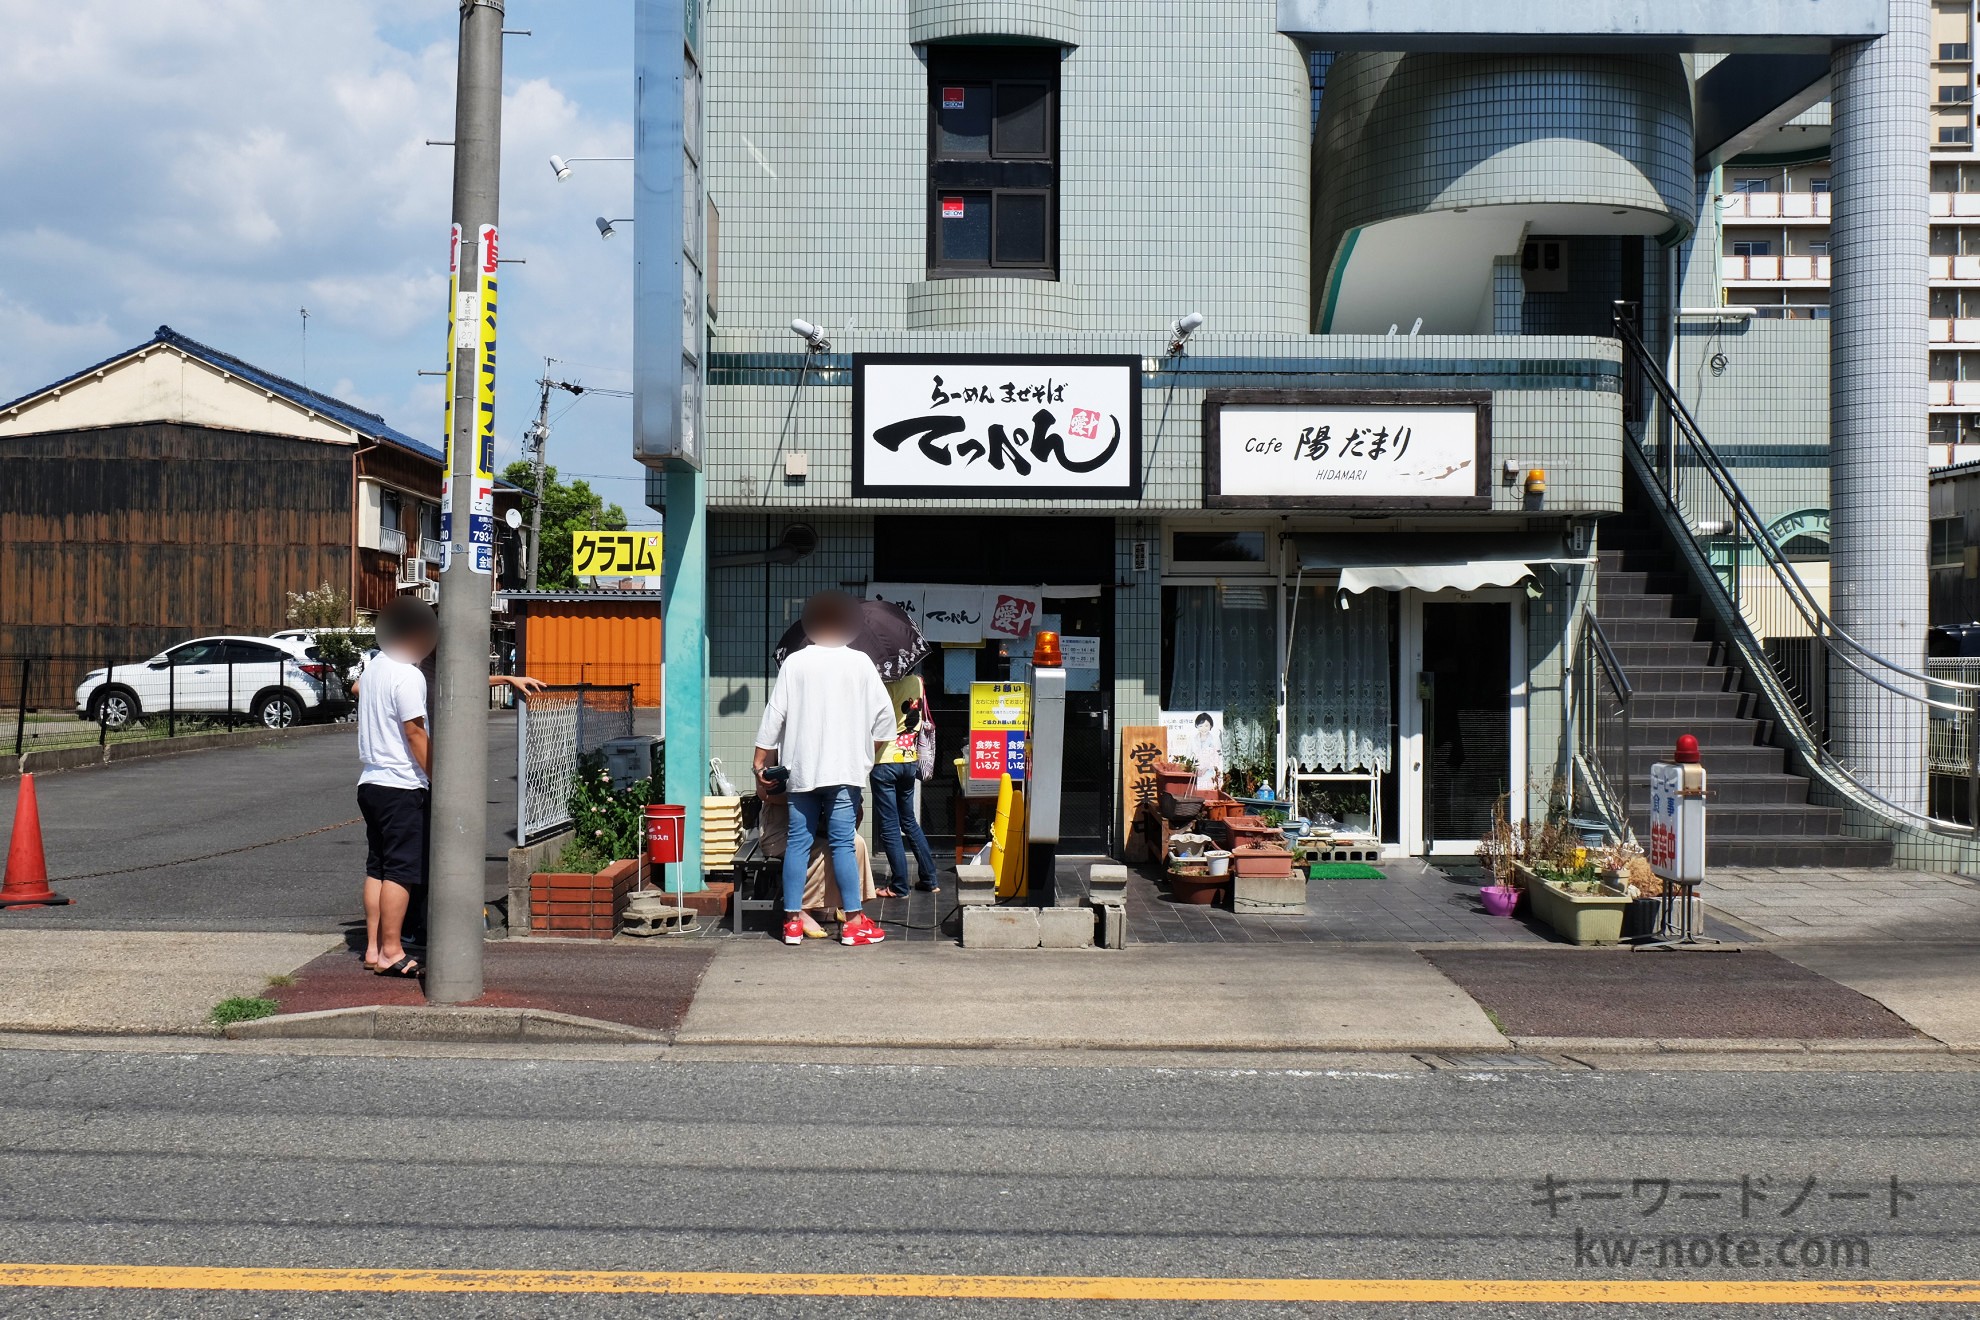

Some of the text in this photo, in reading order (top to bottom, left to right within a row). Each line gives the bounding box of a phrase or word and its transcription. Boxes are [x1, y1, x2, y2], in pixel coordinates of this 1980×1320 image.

[929, 375, 1068, 409] らーめん まぜそば
[873, 409, 1121, 476] てっぺん
[1245, 437, 1283, 455] Cafe
[1316, 469, 1368, 481] HIDAMARI
[576, 535, 656, 572] クラコム
[926, 610, 981, 625] てっぺん
[993, 684, 1021, 692] お願い
[976, 741, 1000, 750] 食券を
[976, 751, 999, 760] 買って
[976, 761, 1000, 770] いる方
